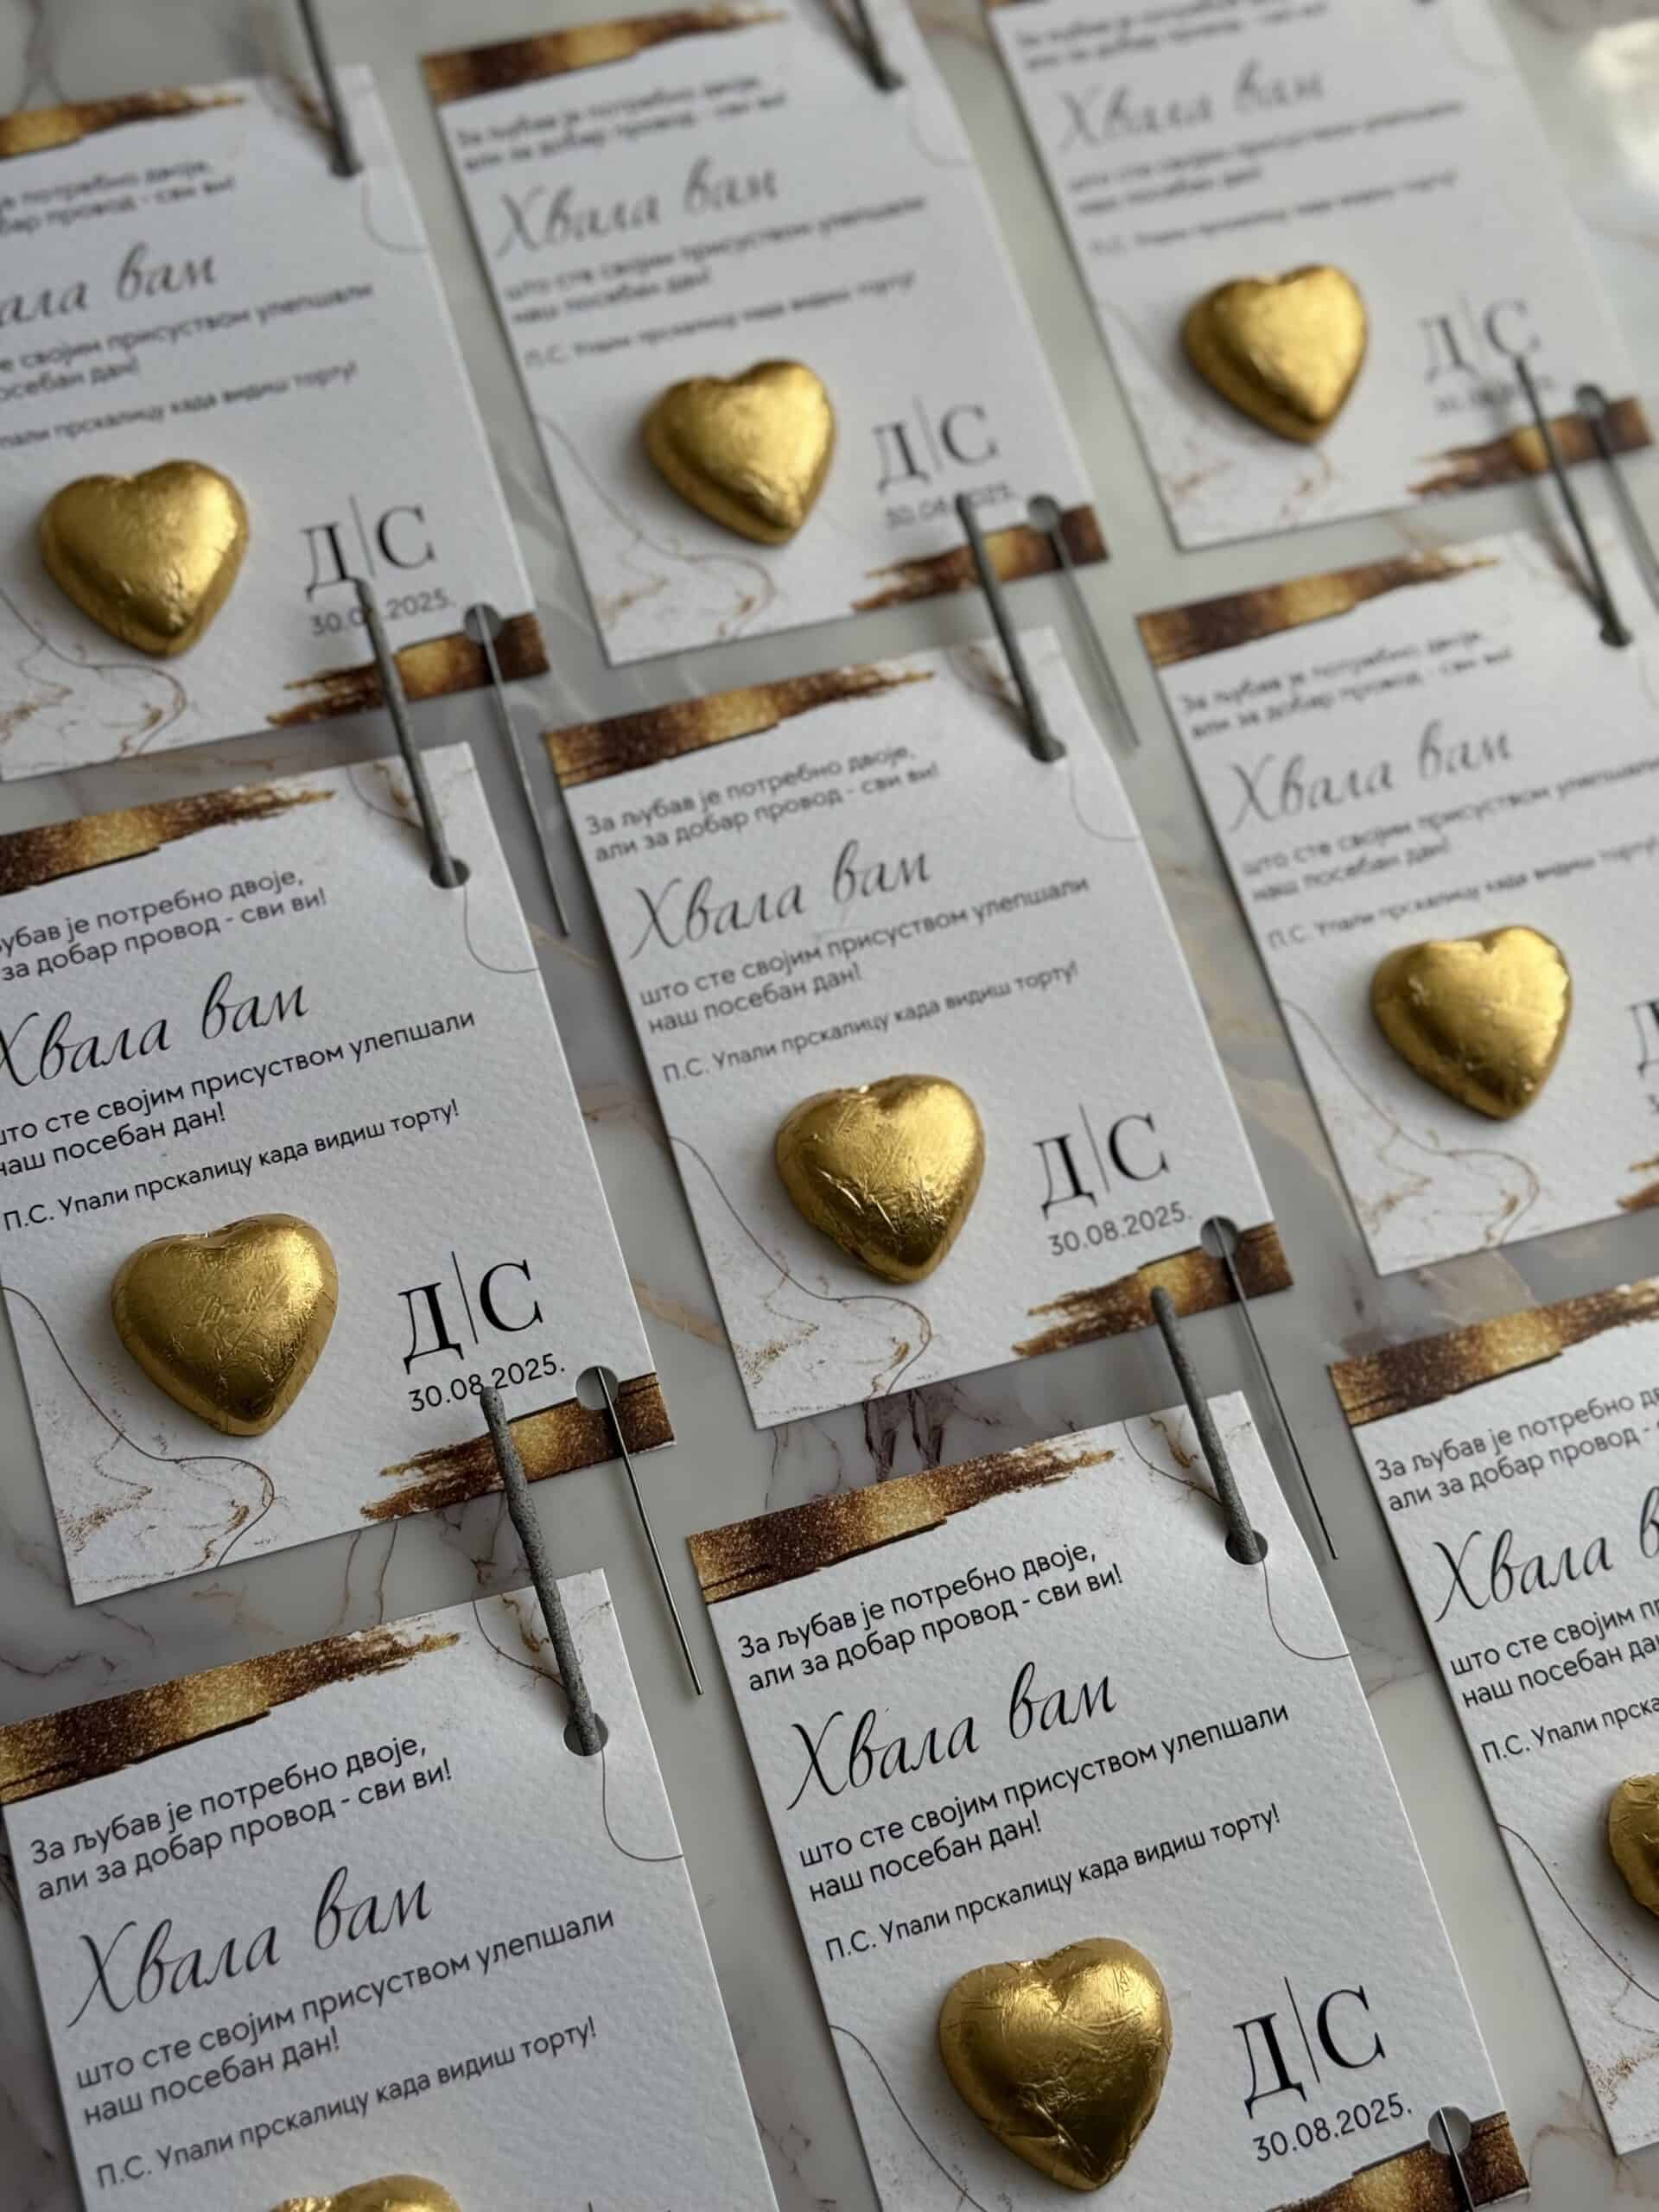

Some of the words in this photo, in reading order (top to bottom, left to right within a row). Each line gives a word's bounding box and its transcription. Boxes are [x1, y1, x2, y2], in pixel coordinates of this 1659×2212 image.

[588, 813, 618, 833] За
[623, 795, 696, 827] љубав
[699, 787, 722, 812] је
[722, 760, 842, 799] потребно
[847, 743, 915, 773] двоје,
[597, 838, 639, 861] али
[644, 830, 671, 849] за
[676, 810, 749, 844] добар
[754, 787, 844, 824] провод
[861, 773, 902, 794] сви
[906, 759, 940, 784] ви!
[0, 925, 61, 958] убав
[66, 916, 90, 943] је
[91, 887, 221, 929] потребно
[227, 869, 302, 902] двоје,
[2, 962, 31, 981] за
[37, 941, 118, 976] добар
[124, 916, 220, 955] провод
[239, 901, 283, 924] сви
[289, 887, 325, 912] ви!
[628, 875, 806, 959] Хвала
[833, 839, 931, 904] вам
[639, 982, 689, 1007] што
[695, 969, 736, 991] сте
[741, 946, 822, 979] својим
[824, 909, 968, 961] присуством
[971, 879, 1089, 927] улепшали
[201, 971, 309, 1039] вам
[648, 1008, 698, 1035] наш
[702, 981, 806, 1020] посебан
[812, 961, 861, 996] дан!
[661, 1058, 709, 1084] П.С.
[710, 1043, 777, 1070] Упали
[780, 1013, 887, 1056] прскалицу
[893, 1001, 940, 1023] када
[944, 982, 1011, 1010] видиш
[1014, 959, 1078, 991] торту!
[45, 1109, 91, 1133] сте
[97, 1084, 185, 1120] својим
[188, 1045, 345, 1100] присуством
[349, 1013, 476, 1064] улепшали
[3, 1204, 54, 1232] П.С.
[57, 1187, 129, 1217] Упали
[133, 1155, 251, 1201] прскалицу
[257, 1141, 308, 1166] када
[313, 1121, 385, 1152] видиш
[389, 1097, 459, 1131] торту!
[52, 1122, 166, 1164] посебан
[173, 1100, 226, 1138] дан!
[1047, 1200, 1193, 1255] 30.08.2025.
[407, 1352, 566, 1414] 30.082025.
[1376, 1458, 1408, 1480] За
[1412, 1437, 1488, 1472] љубав
[1489, 1427, 1514, 1456] је
[1512, 1395, 1635, 1441] потребно
[1389, 1485, 1433, 1511] али
[1437, 1477, 1465, 1497] за
[1469, 1453, 1544, 1492] добар
[1548, 1427, 1641, 1468] провод
[738, 1634, 772, 1659] За
[777, 1611, 857, 1649] љубав
[860, 1601, 886, 1631] је
[885, 1565, 1016, 1615] потребно
[1021, 1543, 1096, 1581] двоје,
[749, 1663, 795, 1692] али
[800, 1654, 830, 1675] за
[836, 1628, 916, 1670] добар
[921, 1598, 1020, 1643] провод
[1037, 1580, 1082, 1605] сви
[1085, 1561, 1123, 1592] ви!
[1432, 1528, 1613, 1623] Хвала
[1450, 1648, 1501, 1676] што
[1506, 1633, 1548, 1658] сте
[1554, 1606, 1636, 1644] својим
[1462, 1678, 1515, 1708] наш
[1517, 1646, 1623, 1691] посебан
[786, 1707, 980, 1810] Хвала
[1008, 1661, 1117, 1739] вам
[798, 1837, 853, 1868] што
[860, 1821, 905, 1848] сте
[911, 1791, 999, 1832] својим
[1001, 1743, 1158, 1808] присуством
[1160, 1704, 1289, 1764] улепшали
[1481, 1733, 1531, 1764] П.С.
[1530, 1716, 1599, 1747] Упали
[29, 1839, 65, 1865] За
[73, 1813, 161, 1855] љубав
[166, 1801, 192, 1834] је
[194, 1761, 337, 1816] потребно
[344, 1737, 425, 1778] двоје,
[38, 1870, 88, 1901] али
[95, 1859, 127, 1883] за
[135, 1831, 223, 1877] добар
[229, 1797, 337, 1847] провод
[357, 1777, 406, 1805] сви
[412, 1757, 452, 1790] ви!
[809, 1869, 864, 1902] наш
[868, 1834, 982, 1884] посебан
[988, 1808, 1042, 1852] дан!
[825, 1929, 877, 1961] П.С.
[879, 1909, 950, 1943] Упали
[955, 1871, 1071, 1924] прскалицу
[1077, 1854, 1129, 1883] када
[1134, 1830, 1206, 1866] видиш
[1209, 1802, 1281, 1841] торту!
[66, 1916, 281, 2029] Хвала
[315, 1865, 433, 1950] вам
[76, 2056, 135, 2090] што
[143, 2039, 192, 2069] сте
[199, 2006, 296, 2051] својим
[299, 1953, 471, 2024] присуством
[475, 1910, 615, 1975] улепшали
[84, 2092, 143, 2127] наш
[149, 2051, 274, 2107] посебан
[282, 2024, 340, 2071] дан!
[96, 2155, 151, 2191] П.С.
[155, 2133, 233, 2171] Упали
[238, 2090, 367, 2149] прскалицу
[374, 2072, 429, 2103] када
[435, 2045, 514, 2085] видиш
[518, 2014, 595, 2057] торту!
[1252, 2092, 1412, 2163] 30.08.2025.
